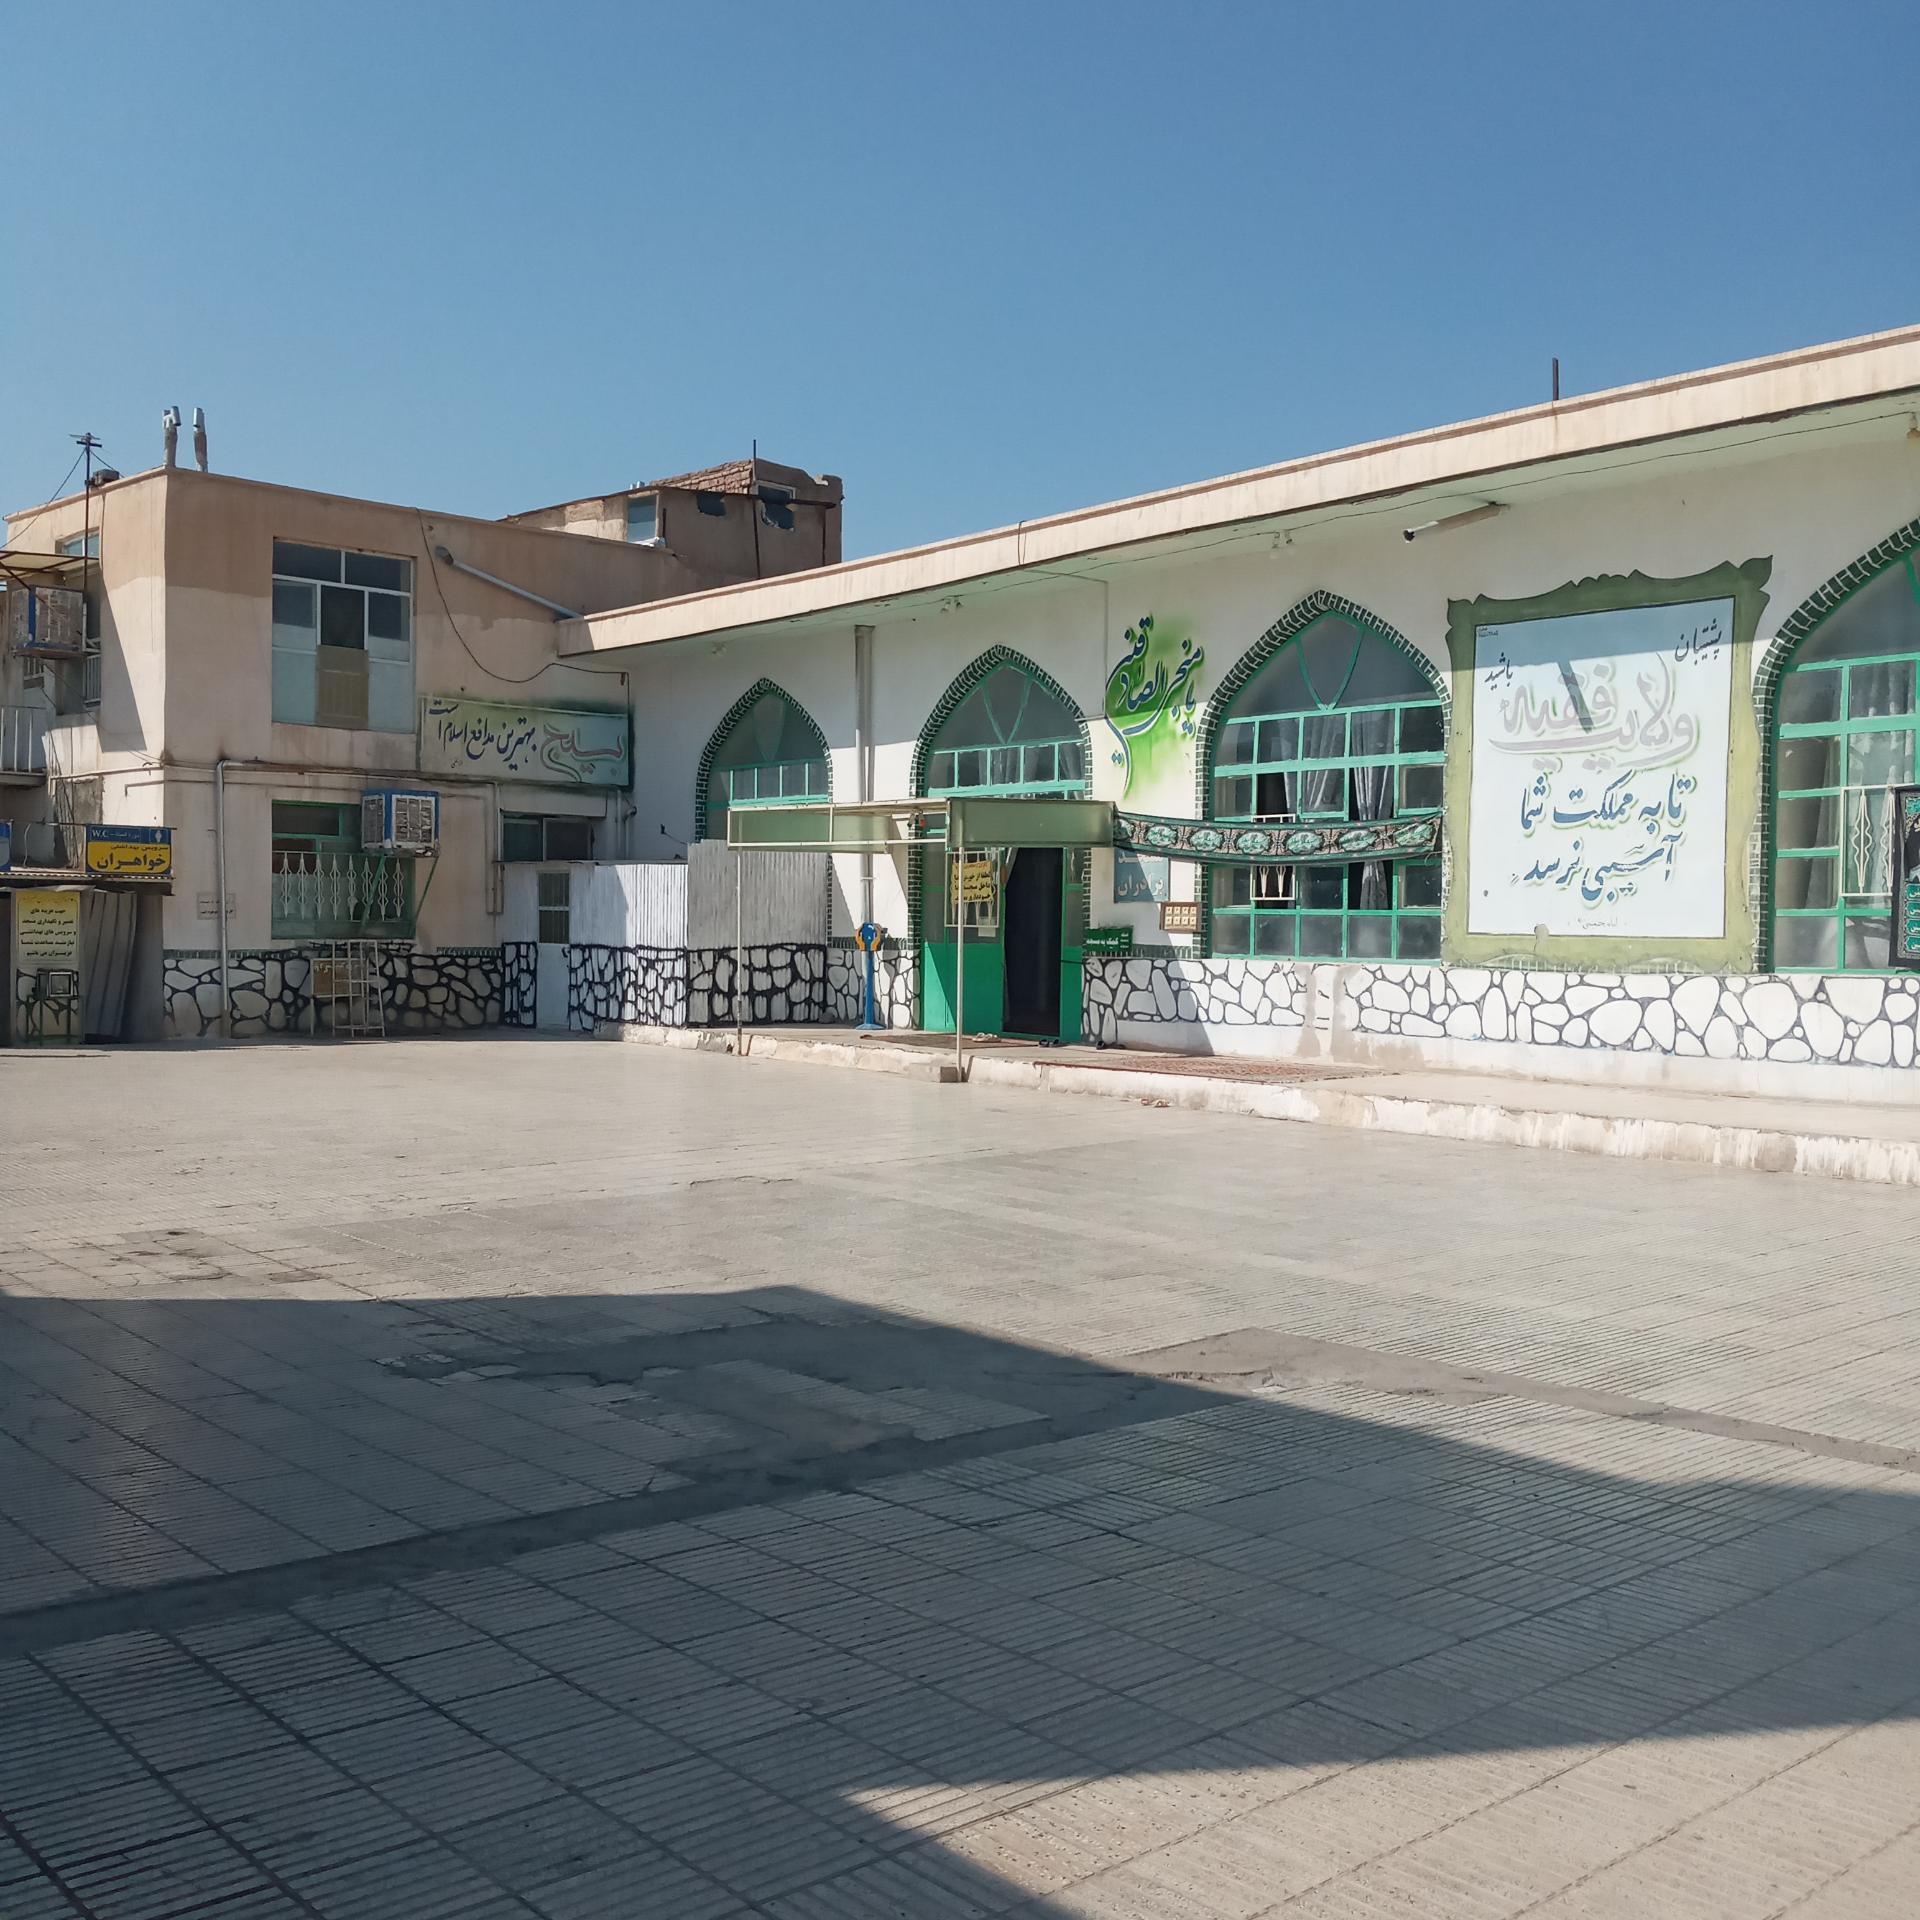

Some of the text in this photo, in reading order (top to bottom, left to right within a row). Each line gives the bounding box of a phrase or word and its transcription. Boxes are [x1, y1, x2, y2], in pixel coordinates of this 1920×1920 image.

[1483, 617, 1723, 772] پشتیبان ولایت فقیه باشید
[442, 720, 468, 752] اسلام
[466, 716, 495, 760] مدافع
[496, 716, 538, 772] بهترین
[540, 720, 626, 784] بسیج
[1520, 769, 1692, 835] تا به مملکت شما
[96, 851, 166, 871] خواهران
[1117, 873, 1165, 897] برادران
[1581, 831, 1683, 902] آسیبی
